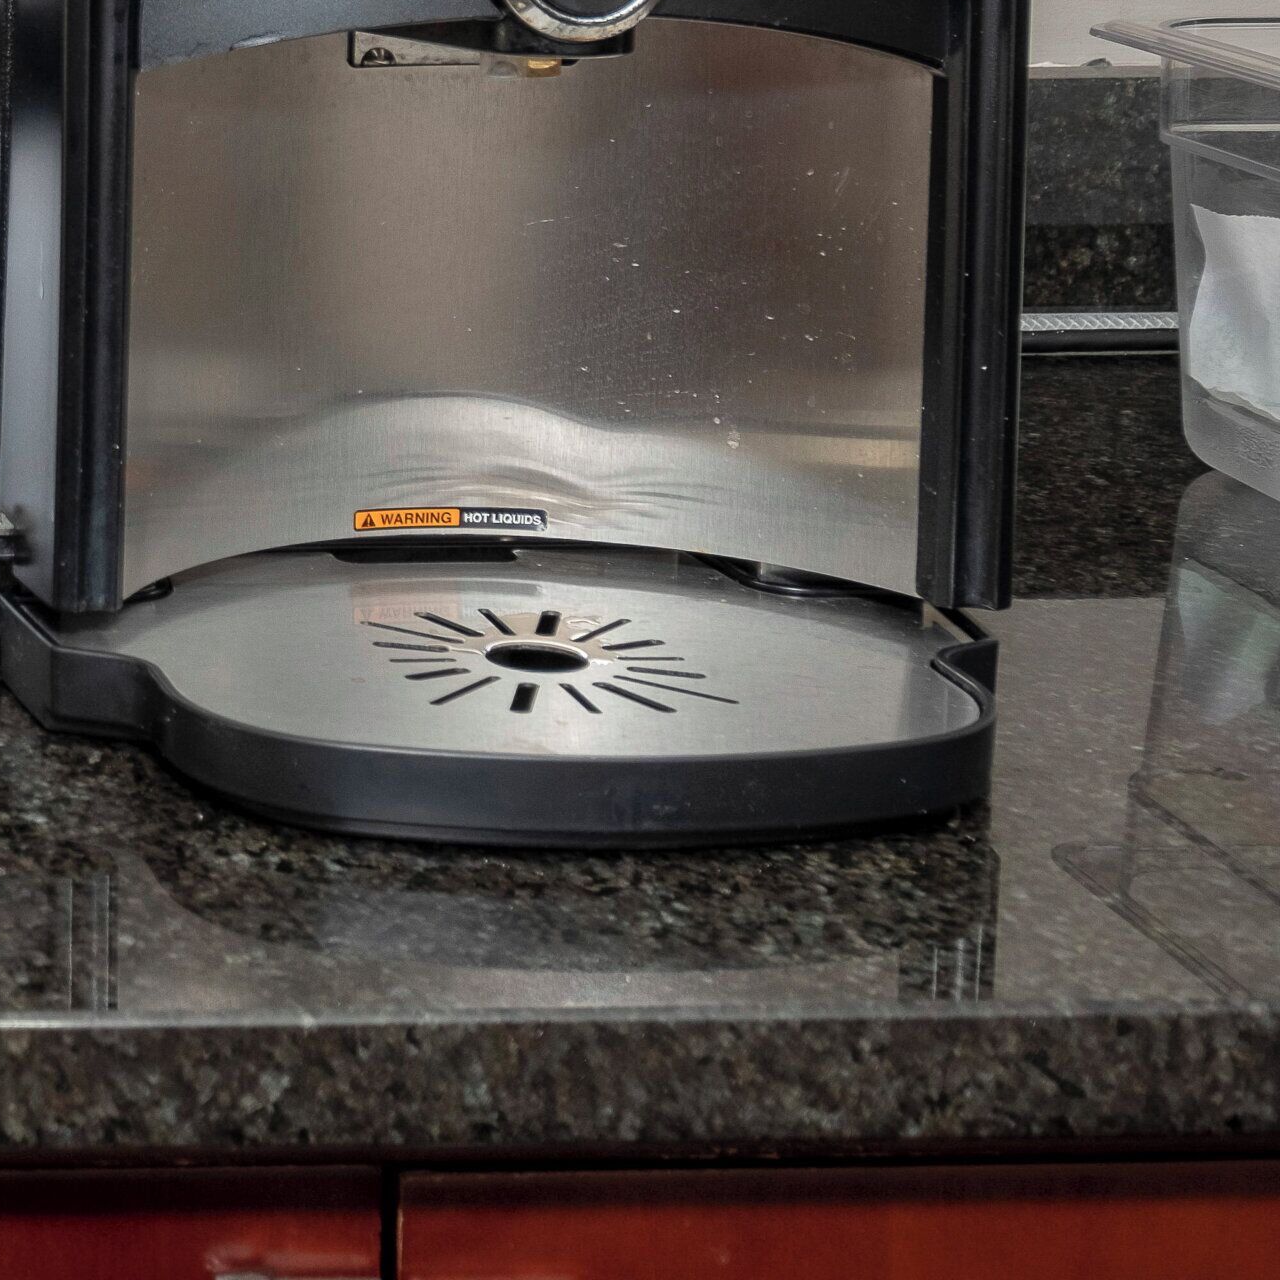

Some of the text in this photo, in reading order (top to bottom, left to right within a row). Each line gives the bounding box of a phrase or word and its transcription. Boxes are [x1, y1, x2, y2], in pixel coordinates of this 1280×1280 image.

[381, 511, 542, 526] WARNING HOT LIQUIDS
